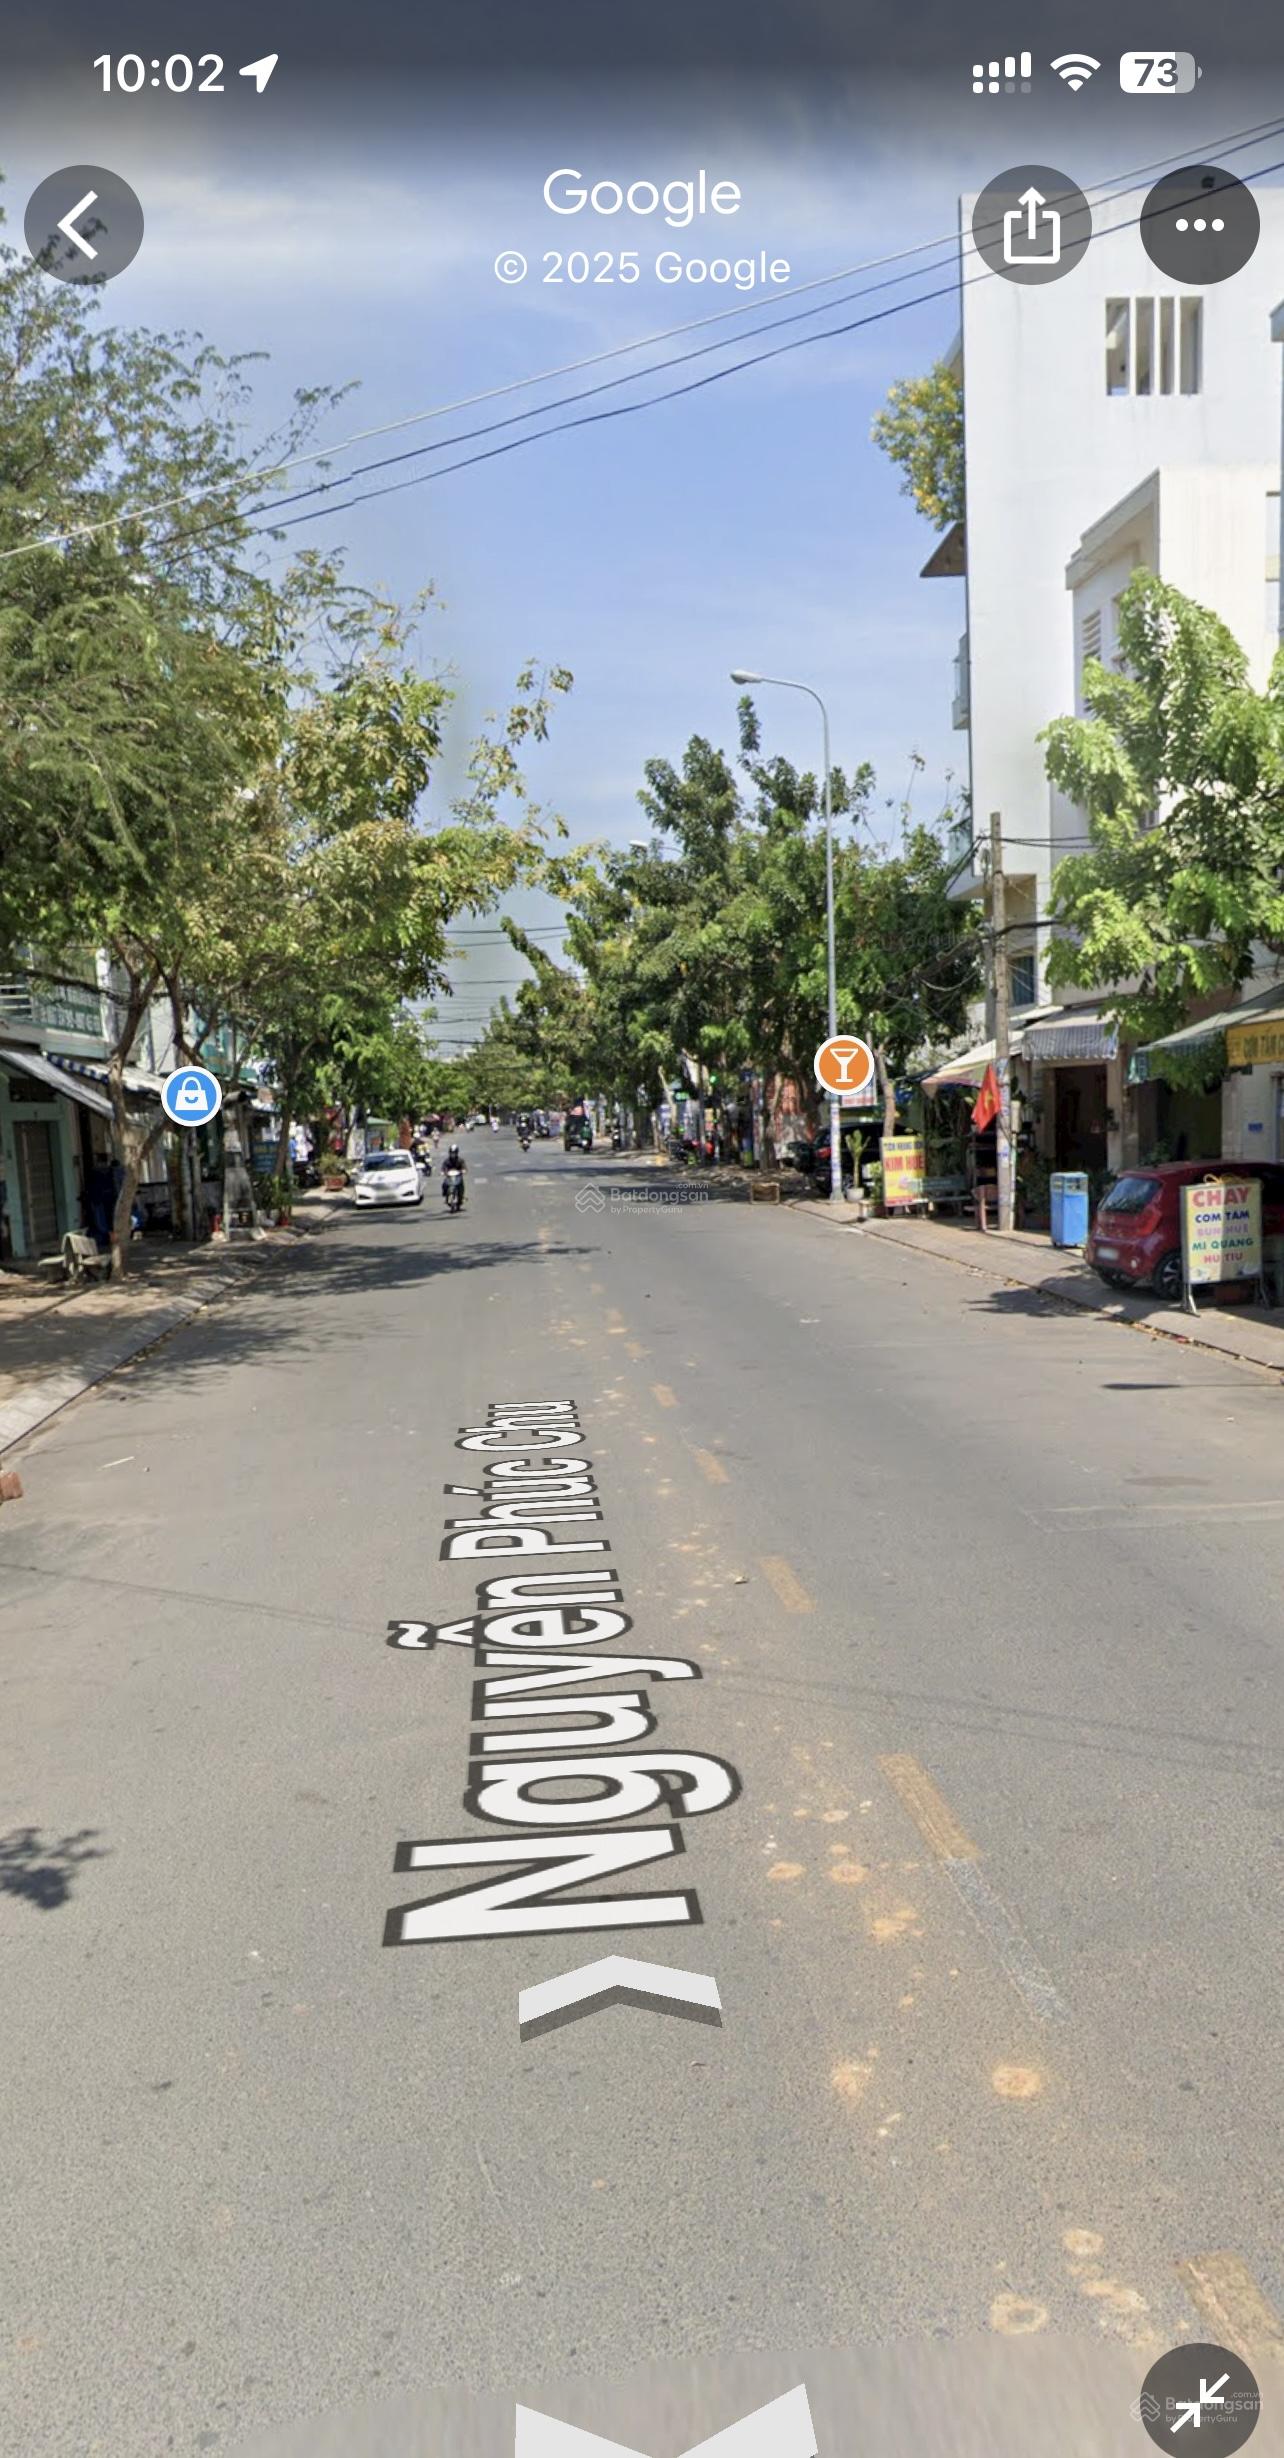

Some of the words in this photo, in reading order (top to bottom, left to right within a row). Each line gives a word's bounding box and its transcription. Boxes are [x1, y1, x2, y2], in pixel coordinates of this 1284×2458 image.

[1192, 1187, 1250, 1207] CHAY
[1195, 1213, 1221, 1223] COM
[1224, 1210, 1249, 1221] TAM
[1192, 1242, 1207, 1251] MI
[1210, 1238, 1253, 1250] QUANG
